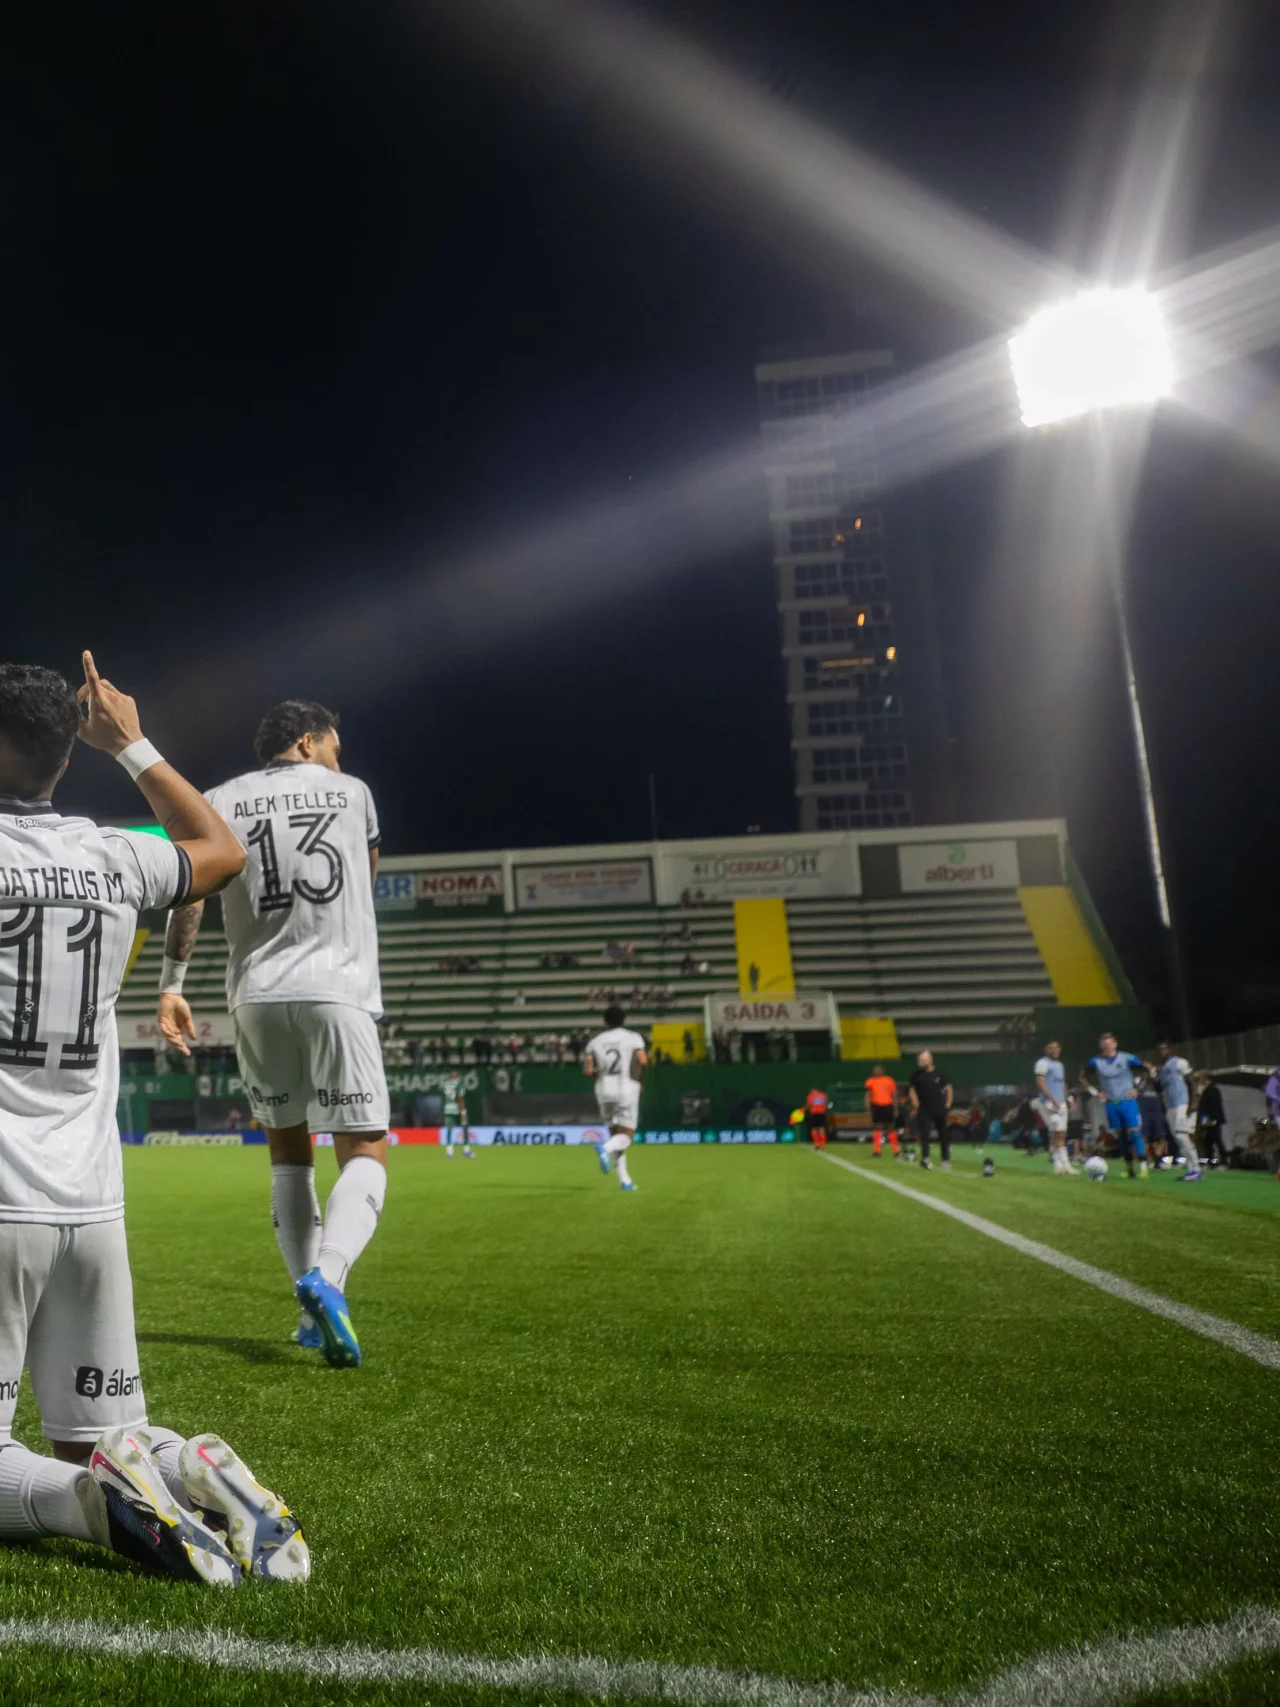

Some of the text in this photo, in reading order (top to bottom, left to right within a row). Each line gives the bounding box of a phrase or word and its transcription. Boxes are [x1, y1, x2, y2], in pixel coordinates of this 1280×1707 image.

[234, 791, 347, 820] ALEX TELLES
[246, 812, 344, 913] 13
[925, 864, 994, 883] alberti
[102, 872, 127, 905] M.
[421, 873, 497, 894] NOMA
[801, 1003, 815, 1019] 3
[606, 1049, 621, 1076] 2
[493, 1131, 566, 1145] Aurora
[105, 1368, 140, 1397] álam
